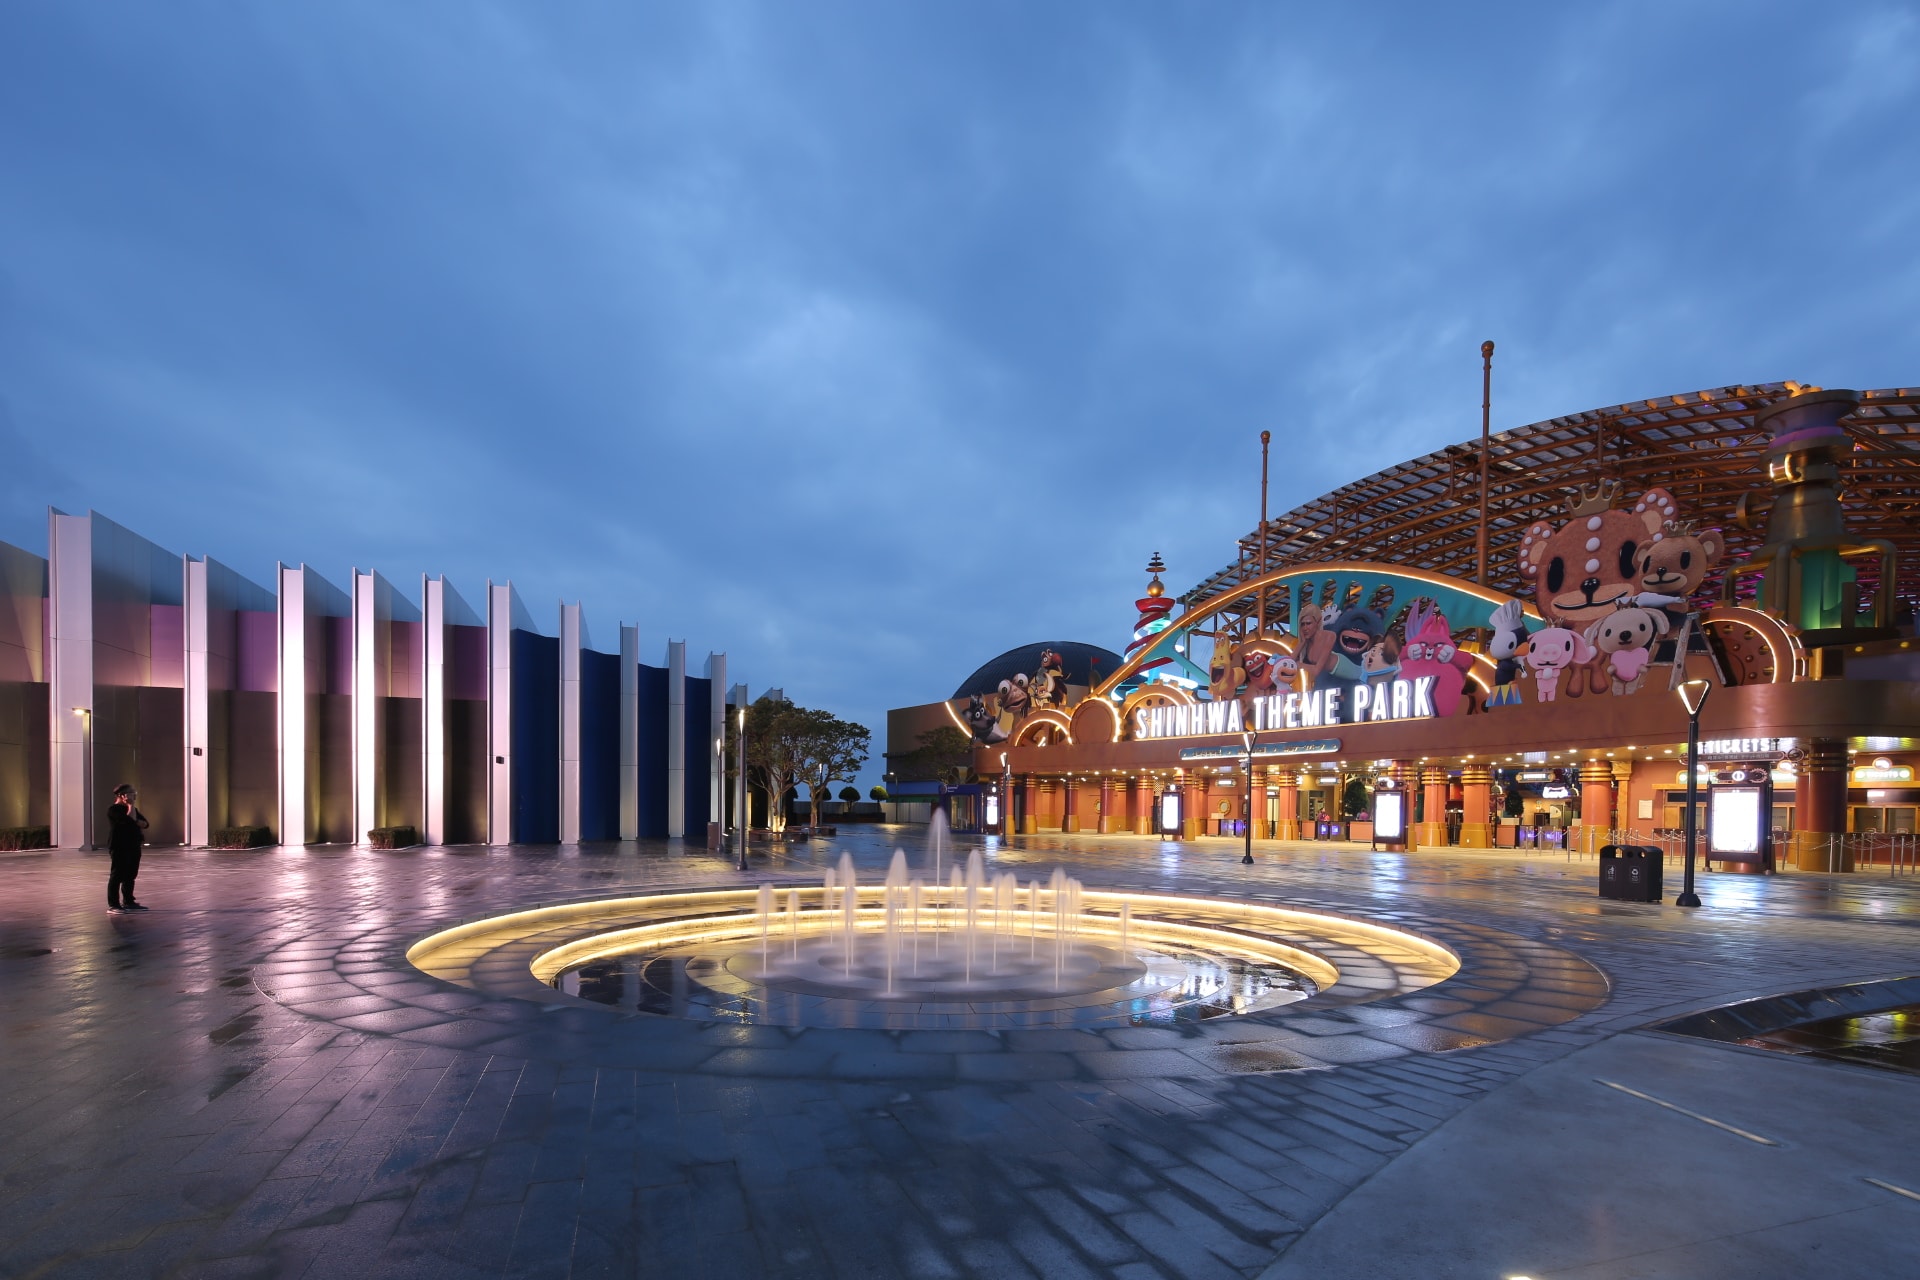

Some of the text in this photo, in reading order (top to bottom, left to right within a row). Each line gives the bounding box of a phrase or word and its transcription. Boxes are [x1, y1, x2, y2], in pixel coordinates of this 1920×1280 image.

[1136, 677, 1436, 739] SHINHWA THEME PARK
[1706, 738, 1770, 754] TICKETS
